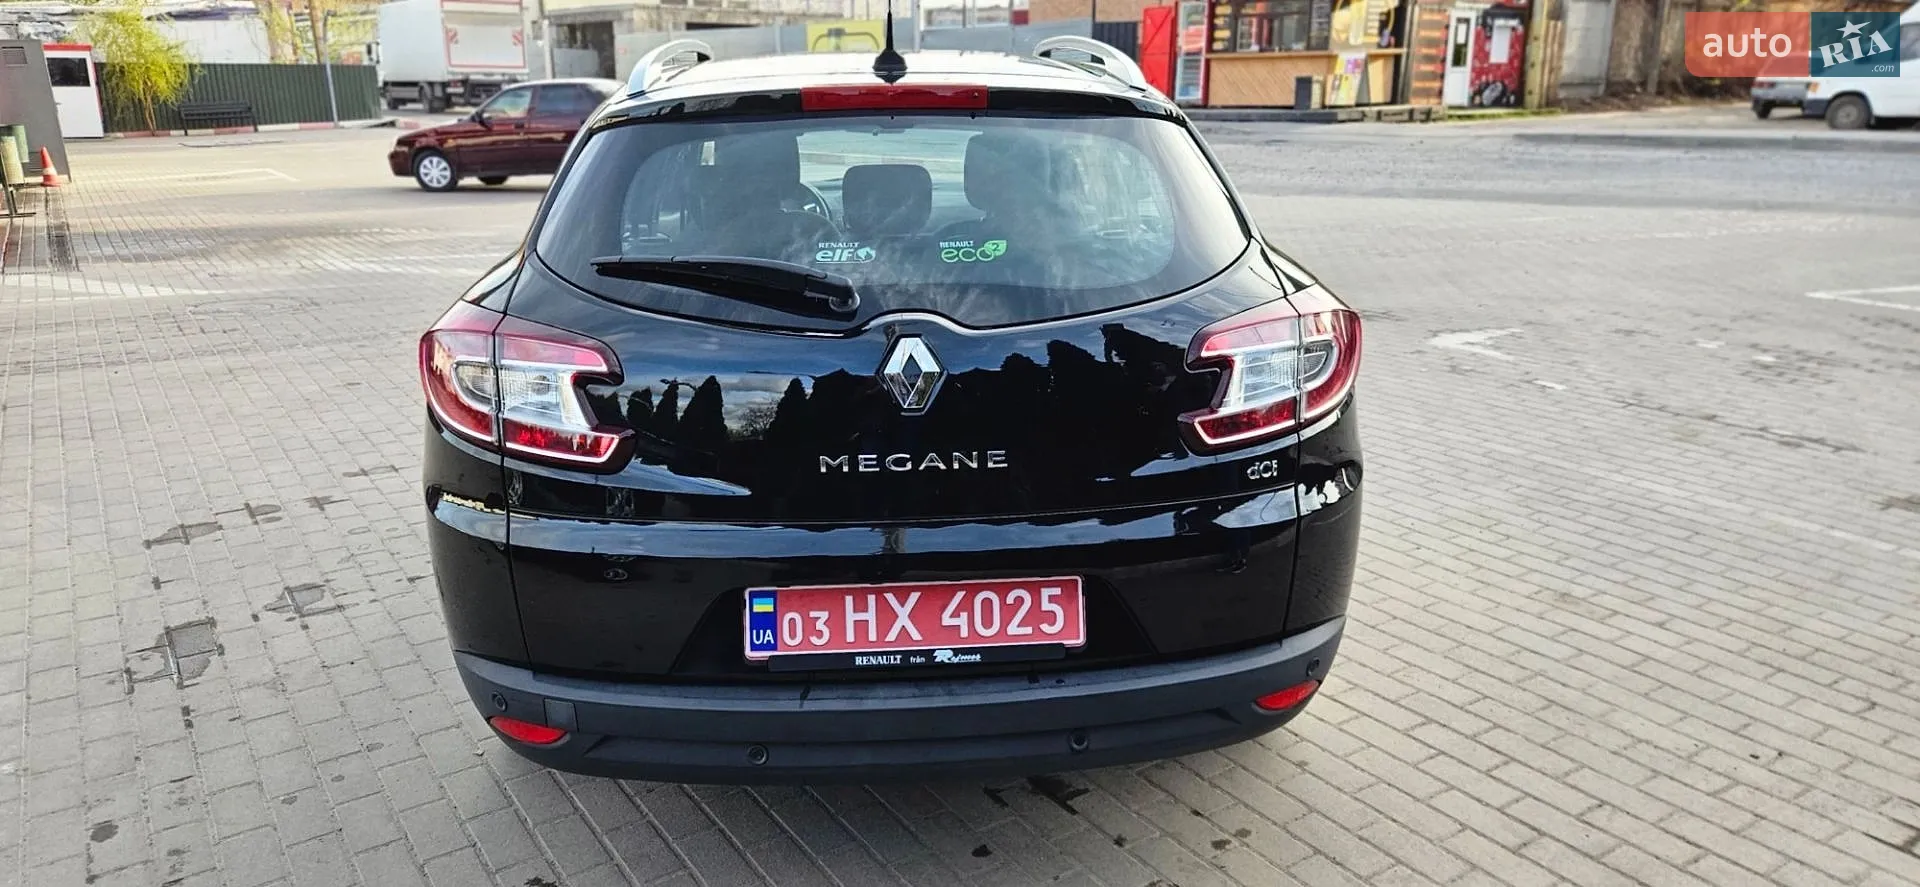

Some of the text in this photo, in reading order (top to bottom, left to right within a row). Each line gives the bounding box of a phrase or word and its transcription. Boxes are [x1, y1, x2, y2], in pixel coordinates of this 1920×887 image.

[819, 450, 1008, 473] MEGANE
[782, 587, 1065, 647] 03 HX 4025
[752, 629, 774, 645] UA
[855, 655, 902, 666] RENAULT
